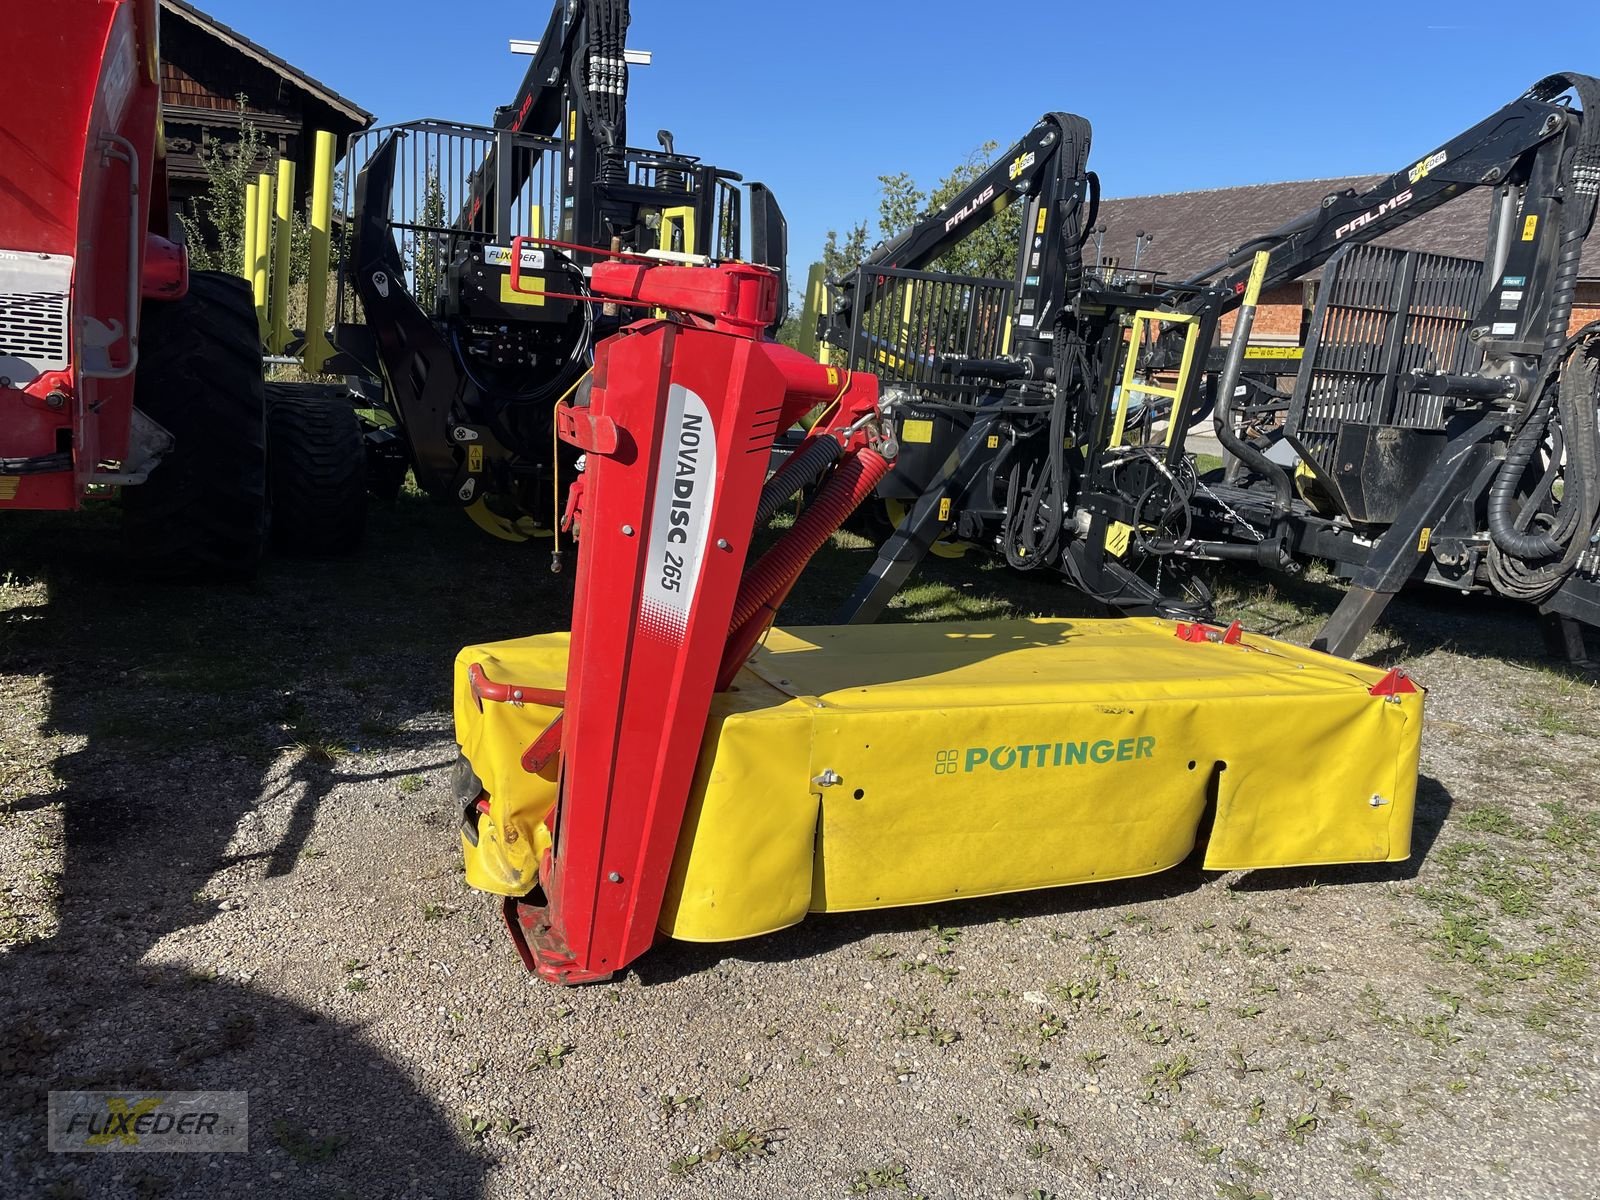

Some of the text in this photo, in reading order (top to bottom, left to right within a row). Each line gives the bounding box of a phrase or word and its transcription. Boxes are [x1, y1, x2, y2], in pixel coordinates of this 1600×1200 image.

[1410, 153, 1446, 178] FLIXEDER
[945, 185, 994, 232] PALMS
[1335, 189, 1413, 239] PALMS
[661, 413, 703, 593] NOVADISC 265
[964, 735, 1156, 772] PÖTTINGER
